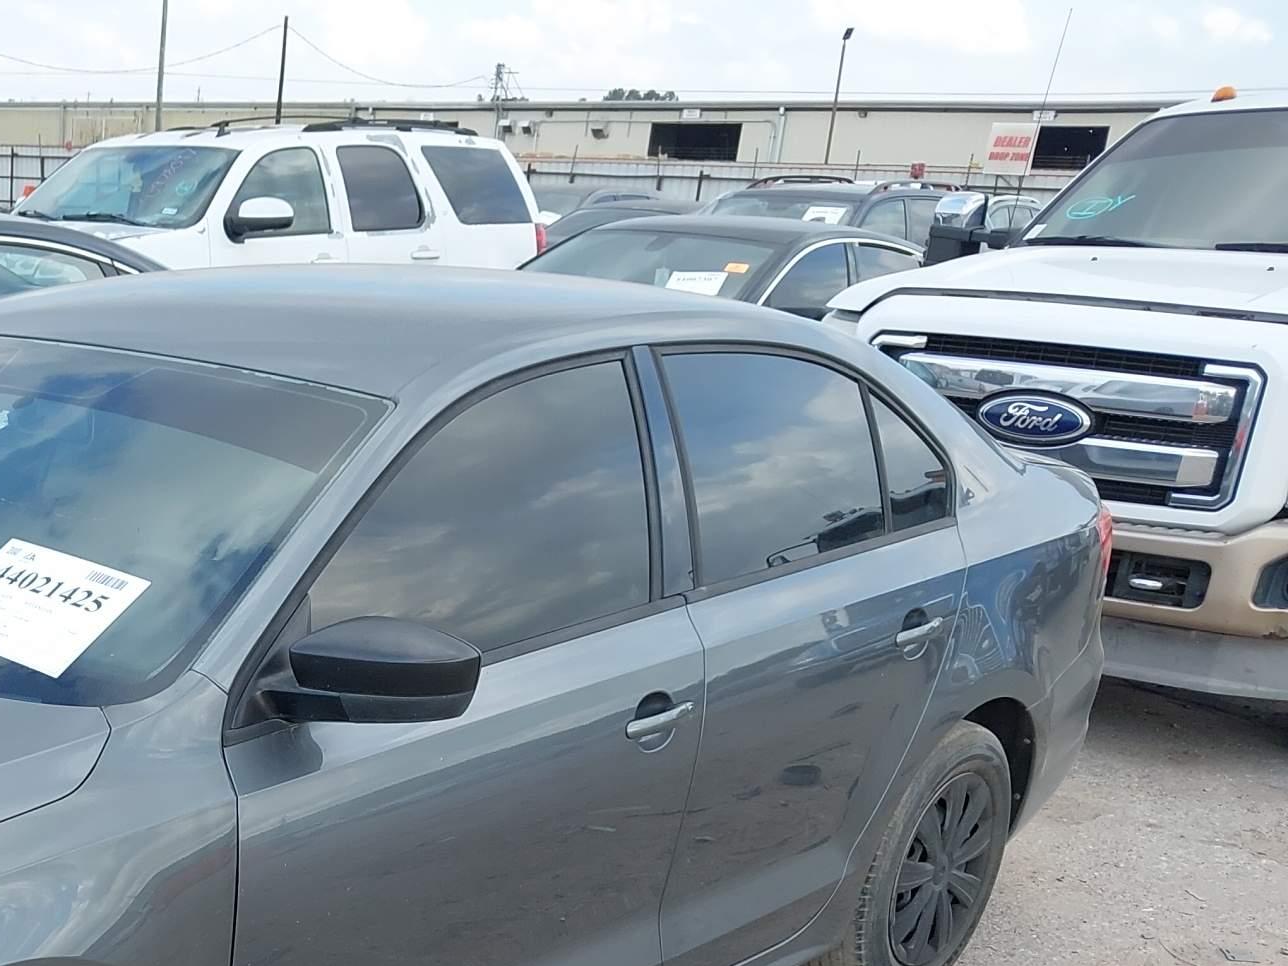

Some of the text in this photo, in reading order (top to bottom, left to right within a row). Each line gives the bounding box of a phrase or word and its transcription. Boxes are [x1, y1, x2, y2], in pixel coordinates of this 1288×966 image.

[993, 136, 1032, 148] DEALER
[988, 151, 1030, 162] DROP ZONE
[1000, 403, 1062, 431] Ford
